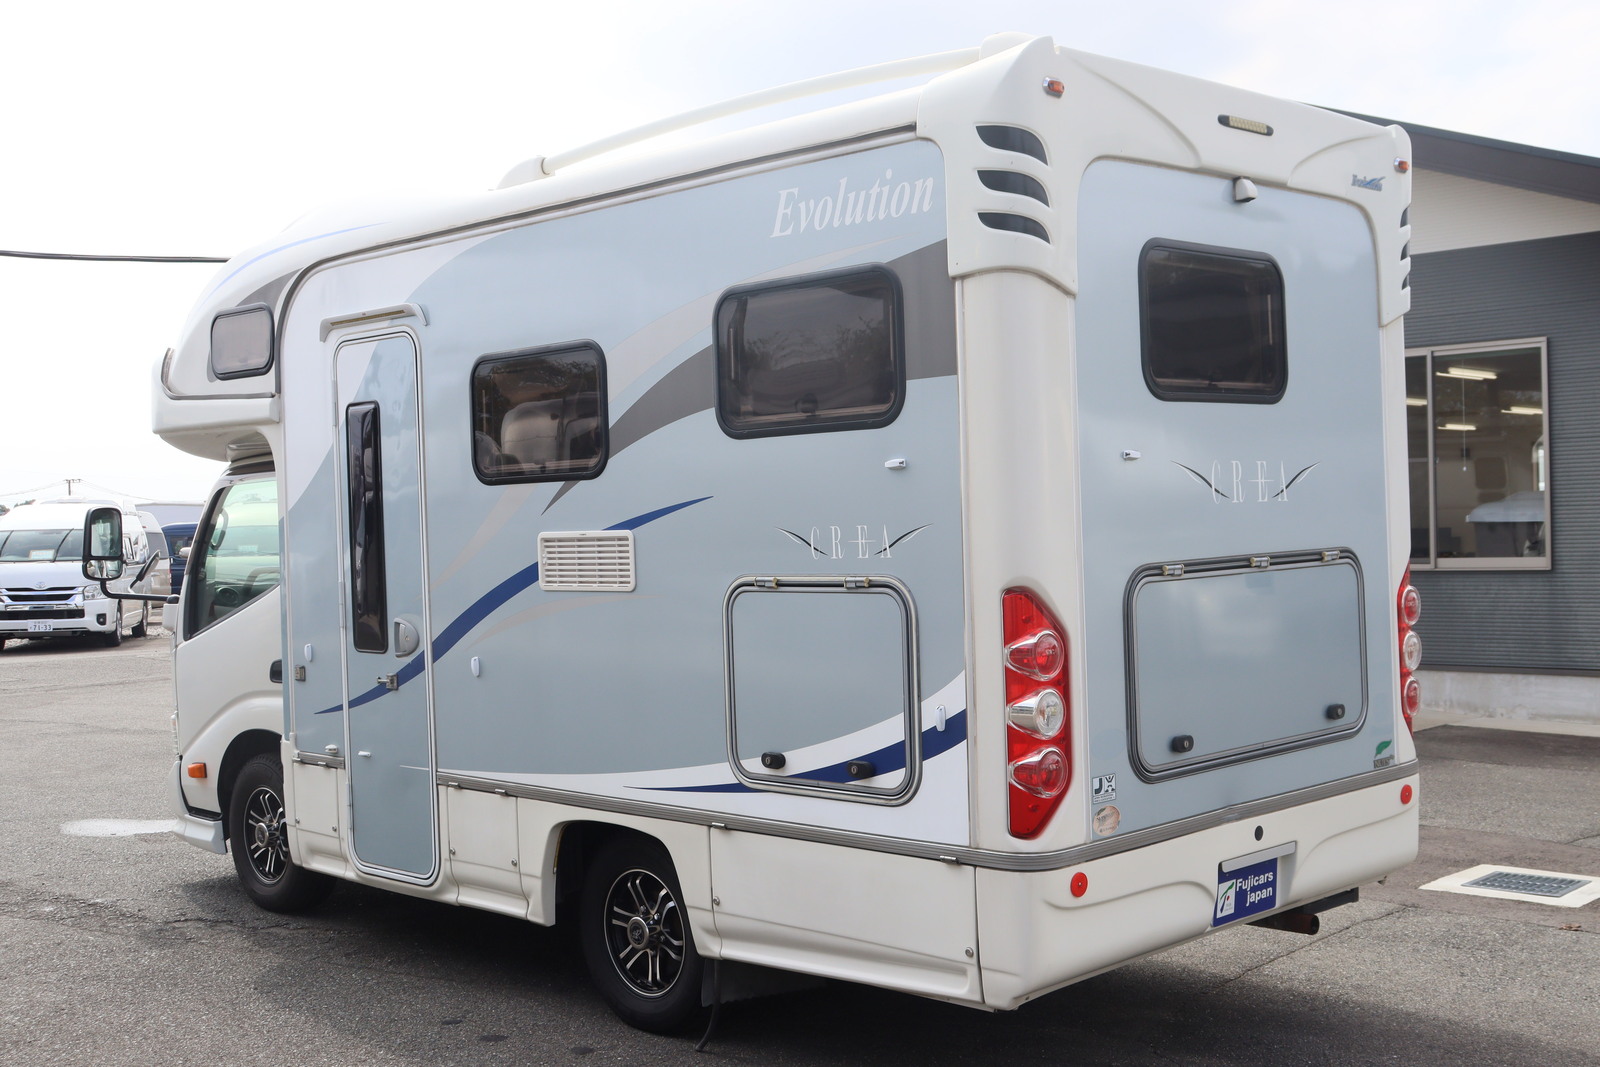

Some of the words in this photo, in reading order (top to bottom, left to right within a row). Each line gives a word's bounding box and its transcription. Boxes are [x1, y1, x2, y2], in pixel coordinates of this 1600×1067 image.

[769, 168, 934, 238] Evolution
[1211, 460, 1289, 504] CREA
[810, 524, 892, 560] CREA
[1236, 872, 1274, 892] Fujicars
[1246, 887, 1273, 907] japan
